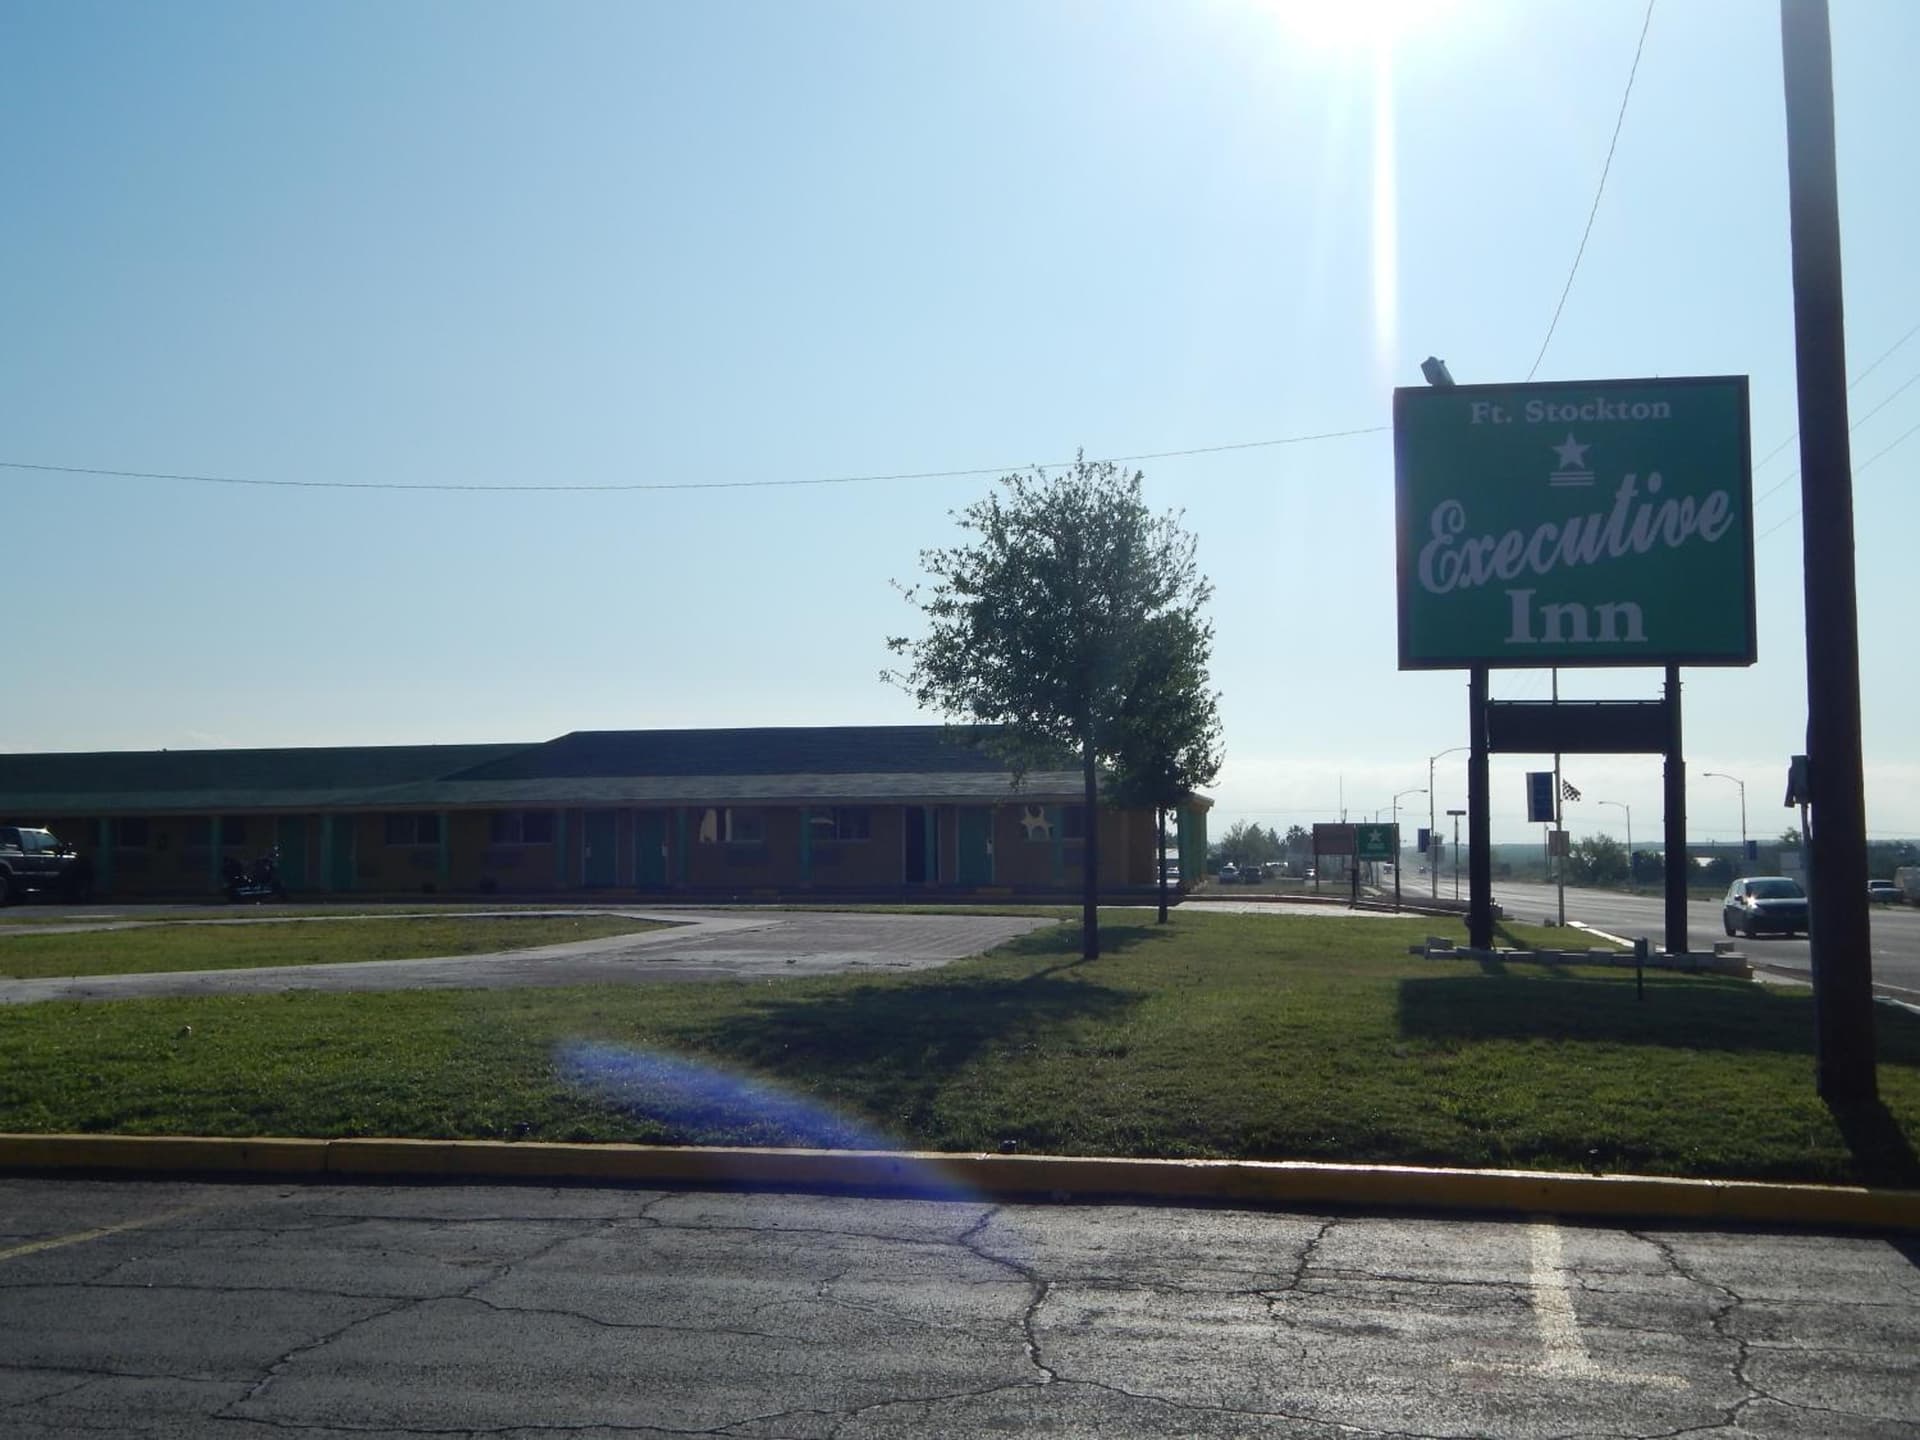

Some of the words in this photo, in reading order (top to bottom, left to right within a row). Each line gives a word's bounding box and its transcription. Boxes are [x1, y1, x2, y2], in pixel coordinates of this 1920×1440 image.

[1470, 401, 1512, 424] Ft.
[1525, 399, 1671, 423] Stockton
[1418, 471, 1734, 594] Executive
[1504, 588, 1649, 643] Inn
